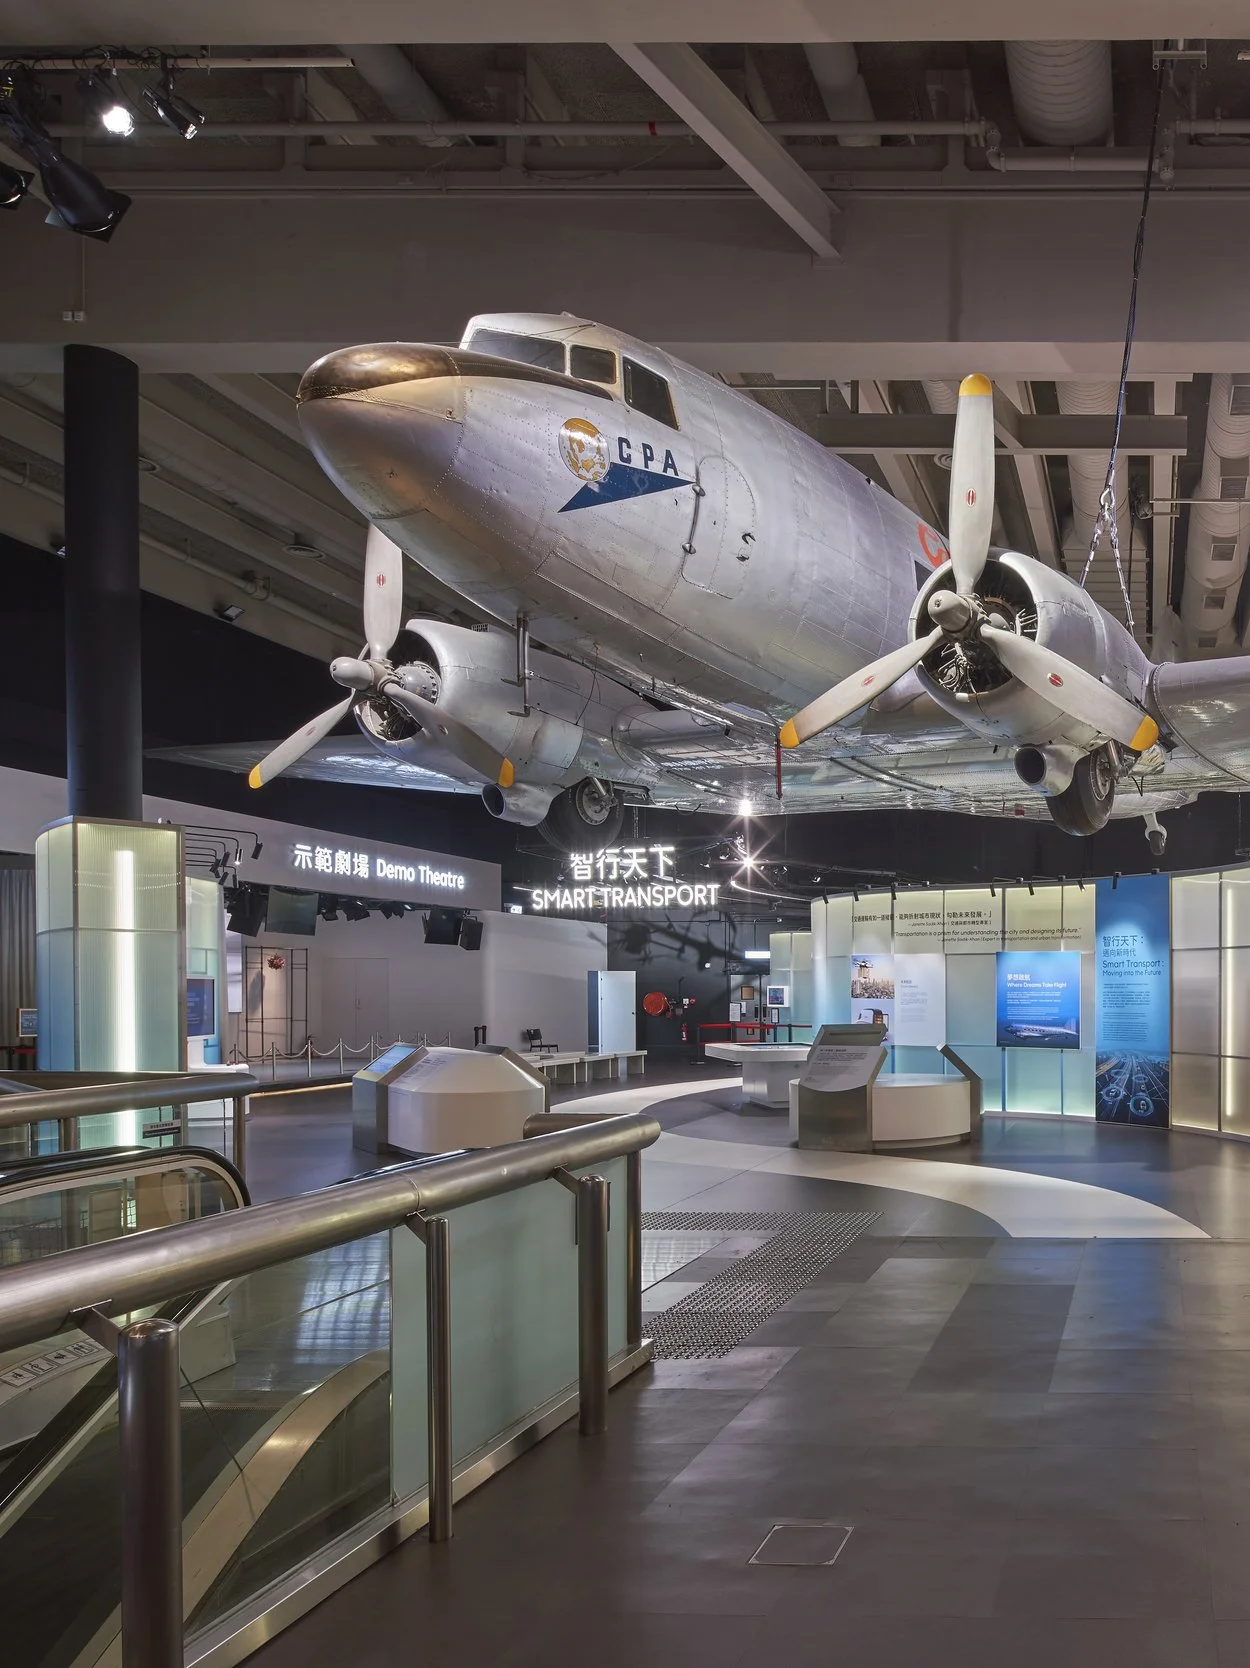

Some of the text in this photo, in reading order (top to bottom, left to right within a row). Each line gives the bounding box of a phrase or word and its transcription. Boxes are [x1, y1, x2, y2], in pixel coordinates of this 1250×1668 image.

[617, 436, 680, 477] CPA
[294, 843, 466, 890] 示範劇場 Demo Theatre
[570, 845, 676, 881] 智行天下
[531, 883, 721, 910] SMART TRANSPORT
[1102, 960, 1125, 969] Smart
[1102, 970, 1123, 978] Moving
